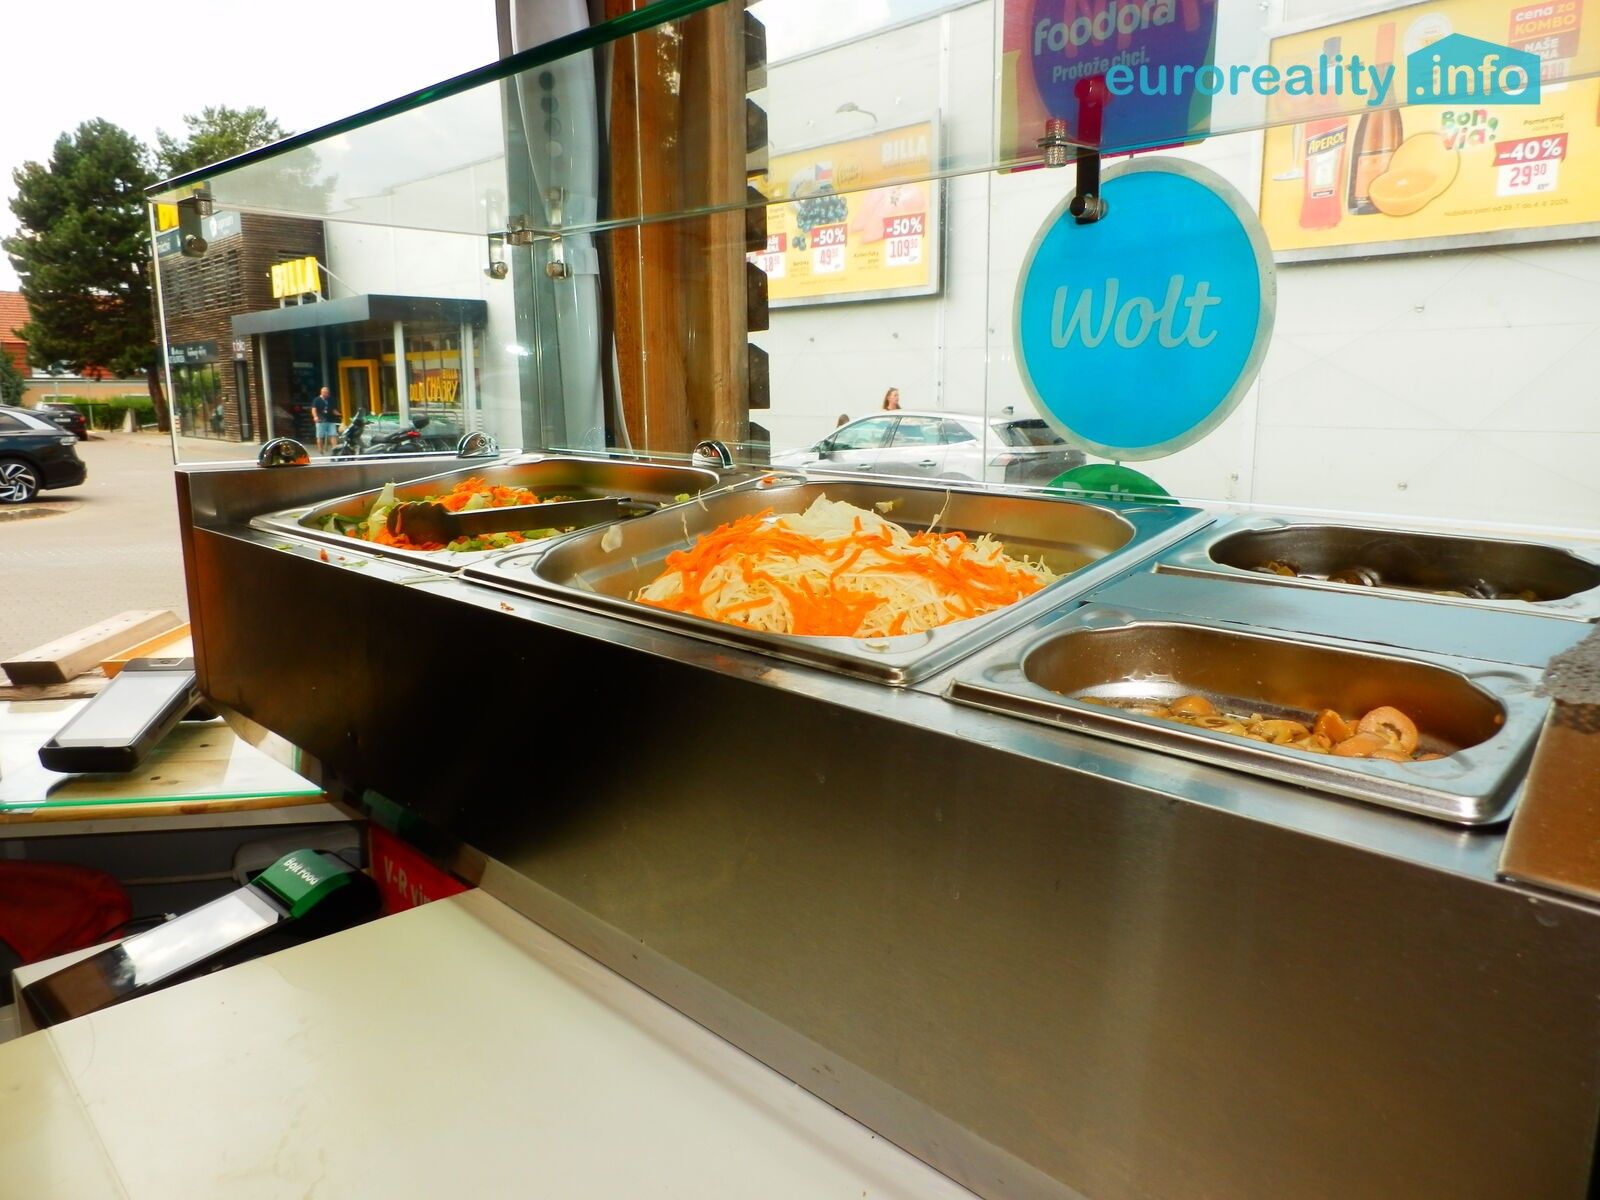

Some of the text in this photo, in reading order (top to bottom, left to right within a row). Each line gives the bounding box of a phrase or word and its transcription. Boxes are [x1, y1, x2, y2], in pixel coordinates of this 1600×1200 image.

[1515, 1, 1576, 22] cena za
[1034, 0, 1176, 56] foodora
[1514, 14, 1577, 35] KOMBO
[1308, 131, 1345, 154] APEROL
[1498, 137, 1563, 161] -40%
[813, 226, 846, 245] -50%
[885, 219, 923, 236] -50%
[1050, 274, 1223, 349] Wolt
